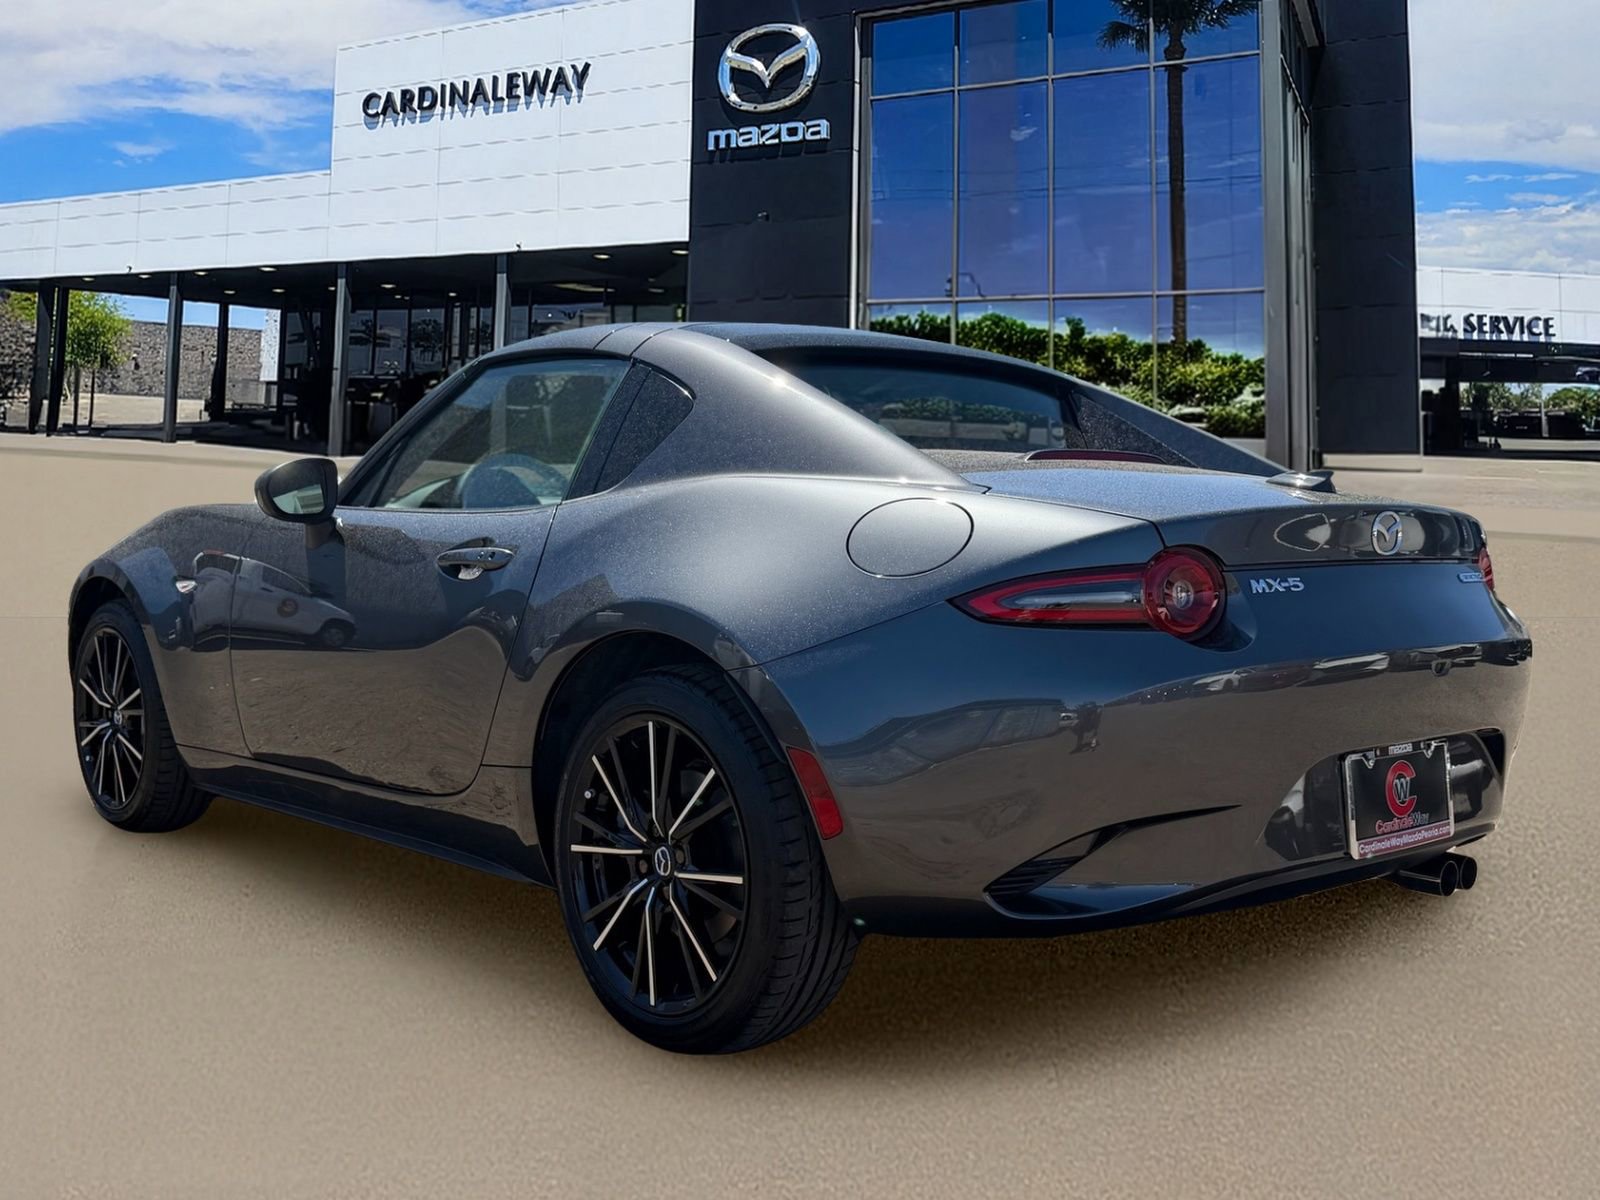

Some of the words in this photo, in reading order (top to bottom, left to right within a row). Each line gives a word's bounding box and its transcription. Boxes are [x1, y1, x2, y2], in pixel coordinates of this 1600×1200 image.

[362, 62, 591, 117] CARDINALEWAY
[707, 119, 830, 150] mazda
[1463, 313, 1556, 337] SERVICE
[1250, 577, 1304, 594] MX-5
